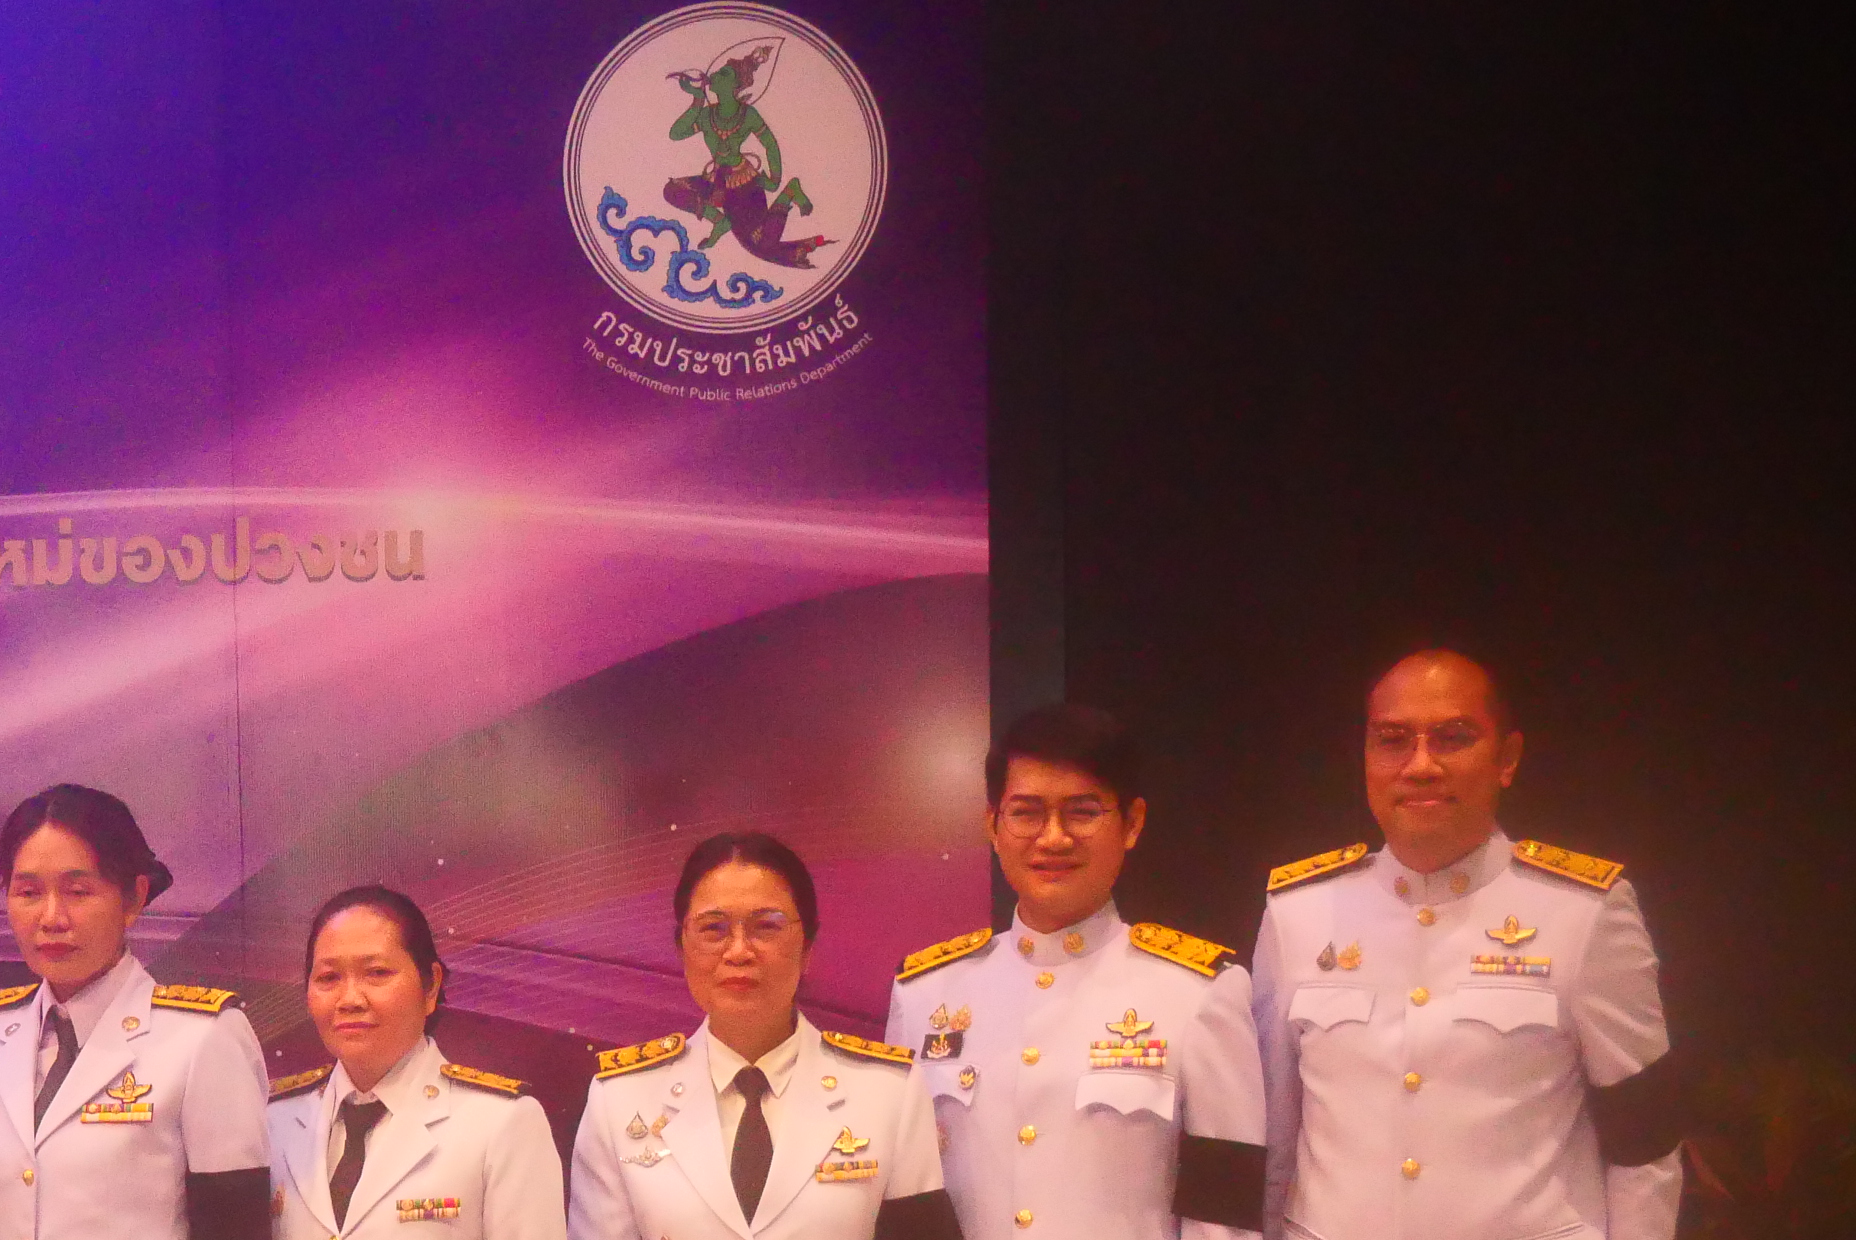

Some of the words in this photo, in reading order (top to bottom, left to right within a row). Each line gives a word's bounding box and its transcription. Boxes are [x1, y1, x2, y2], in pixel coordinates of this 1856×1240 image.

[582, 336, 605, 362] The
[606, 356, 685, 398] Government
[689, 386, 731, 401] Public
[735, 377, 798, 401] Relations
[799, 331, 873, 385] Department
[593, 294, 860, 376] กรมประชาสัมพันธ์
